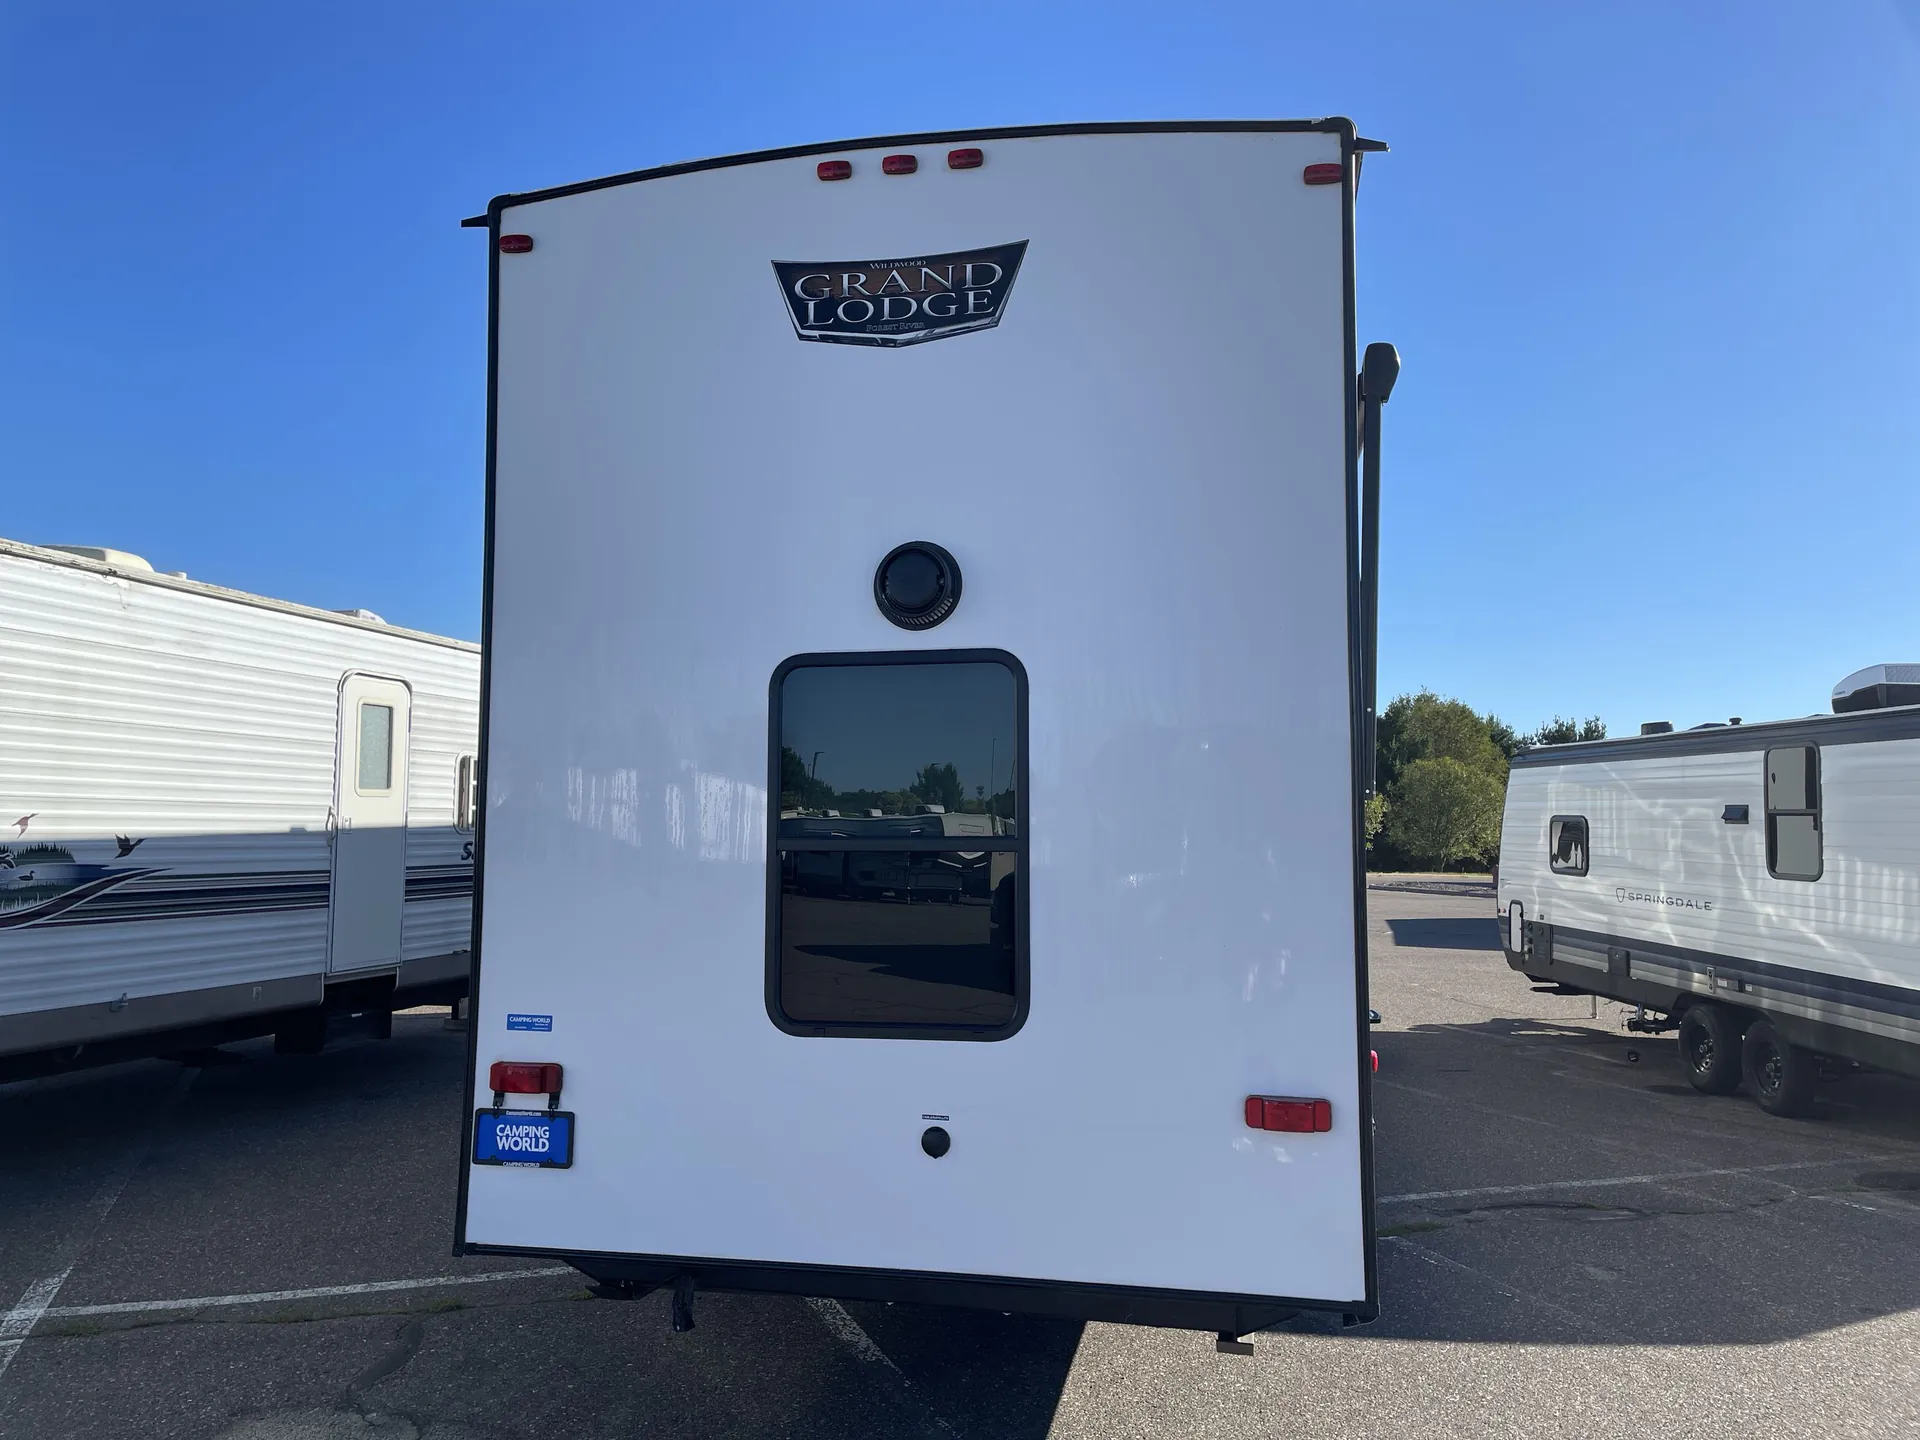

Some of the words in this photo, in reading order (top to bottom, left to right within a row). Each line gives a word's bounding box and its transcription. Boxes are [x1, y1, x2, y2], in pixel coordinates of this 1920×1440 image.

[870, 259, 927, 270] WILDWOOD
[794, 262, 1003, 300] GRAND
[803, 289, 995, 327] LODGE
[1627, 892, 1713, 911] SPRINGDALE
[496, 1124, 550, 1139] CAMPING
[496, 1136, 550, 1152] WORLD
